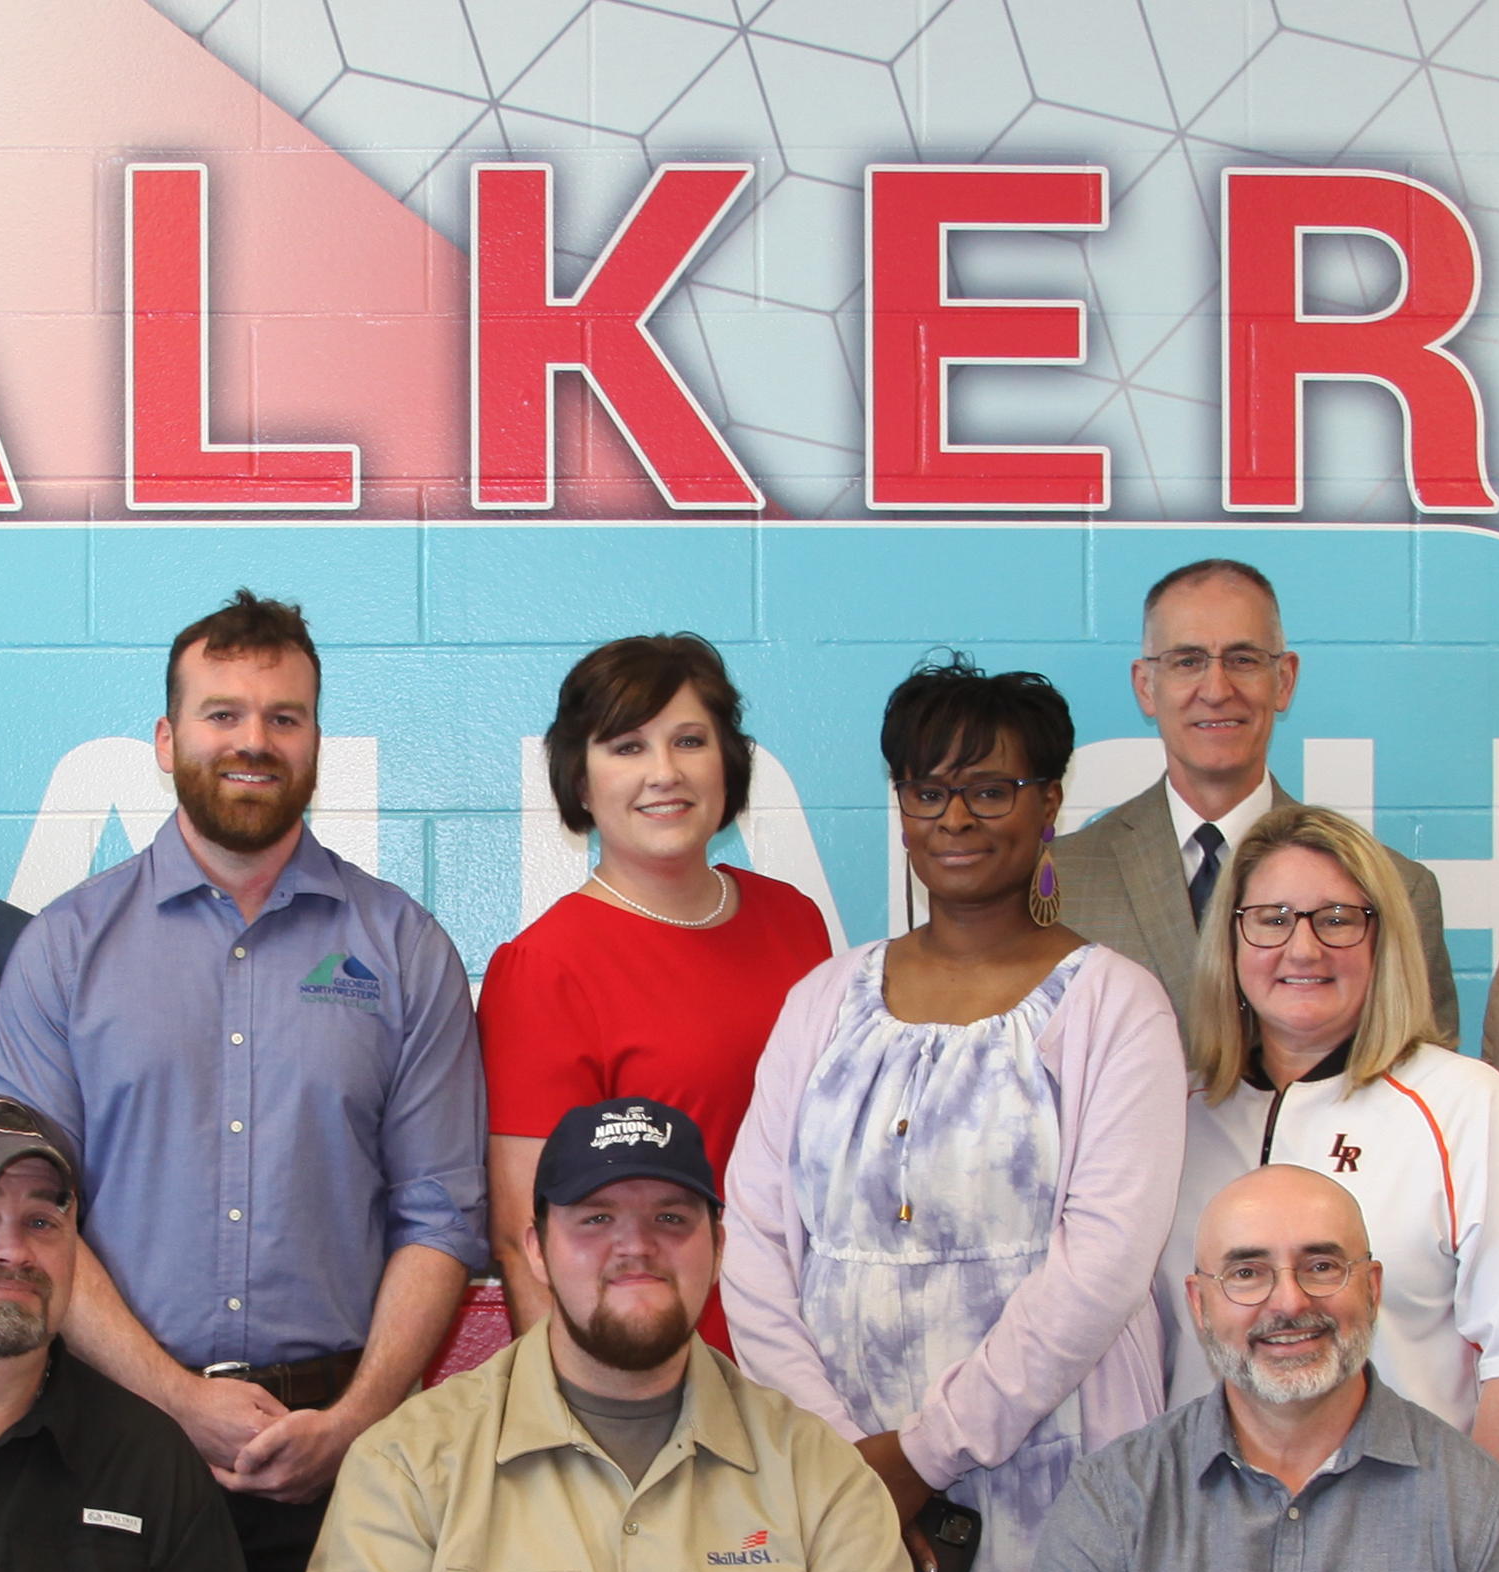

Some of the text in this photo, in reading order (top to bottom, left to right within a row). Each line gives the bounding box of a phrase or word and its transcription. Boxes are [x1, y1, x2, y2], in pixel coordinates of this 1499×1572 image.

[333, 978, 381, 991] GEORGIA
[595, 1121, 664, 1138] NATIONAL
[590, 1132, 669, 1150] signing day
[707, 1549, 772, 1566] SkillsUSA
